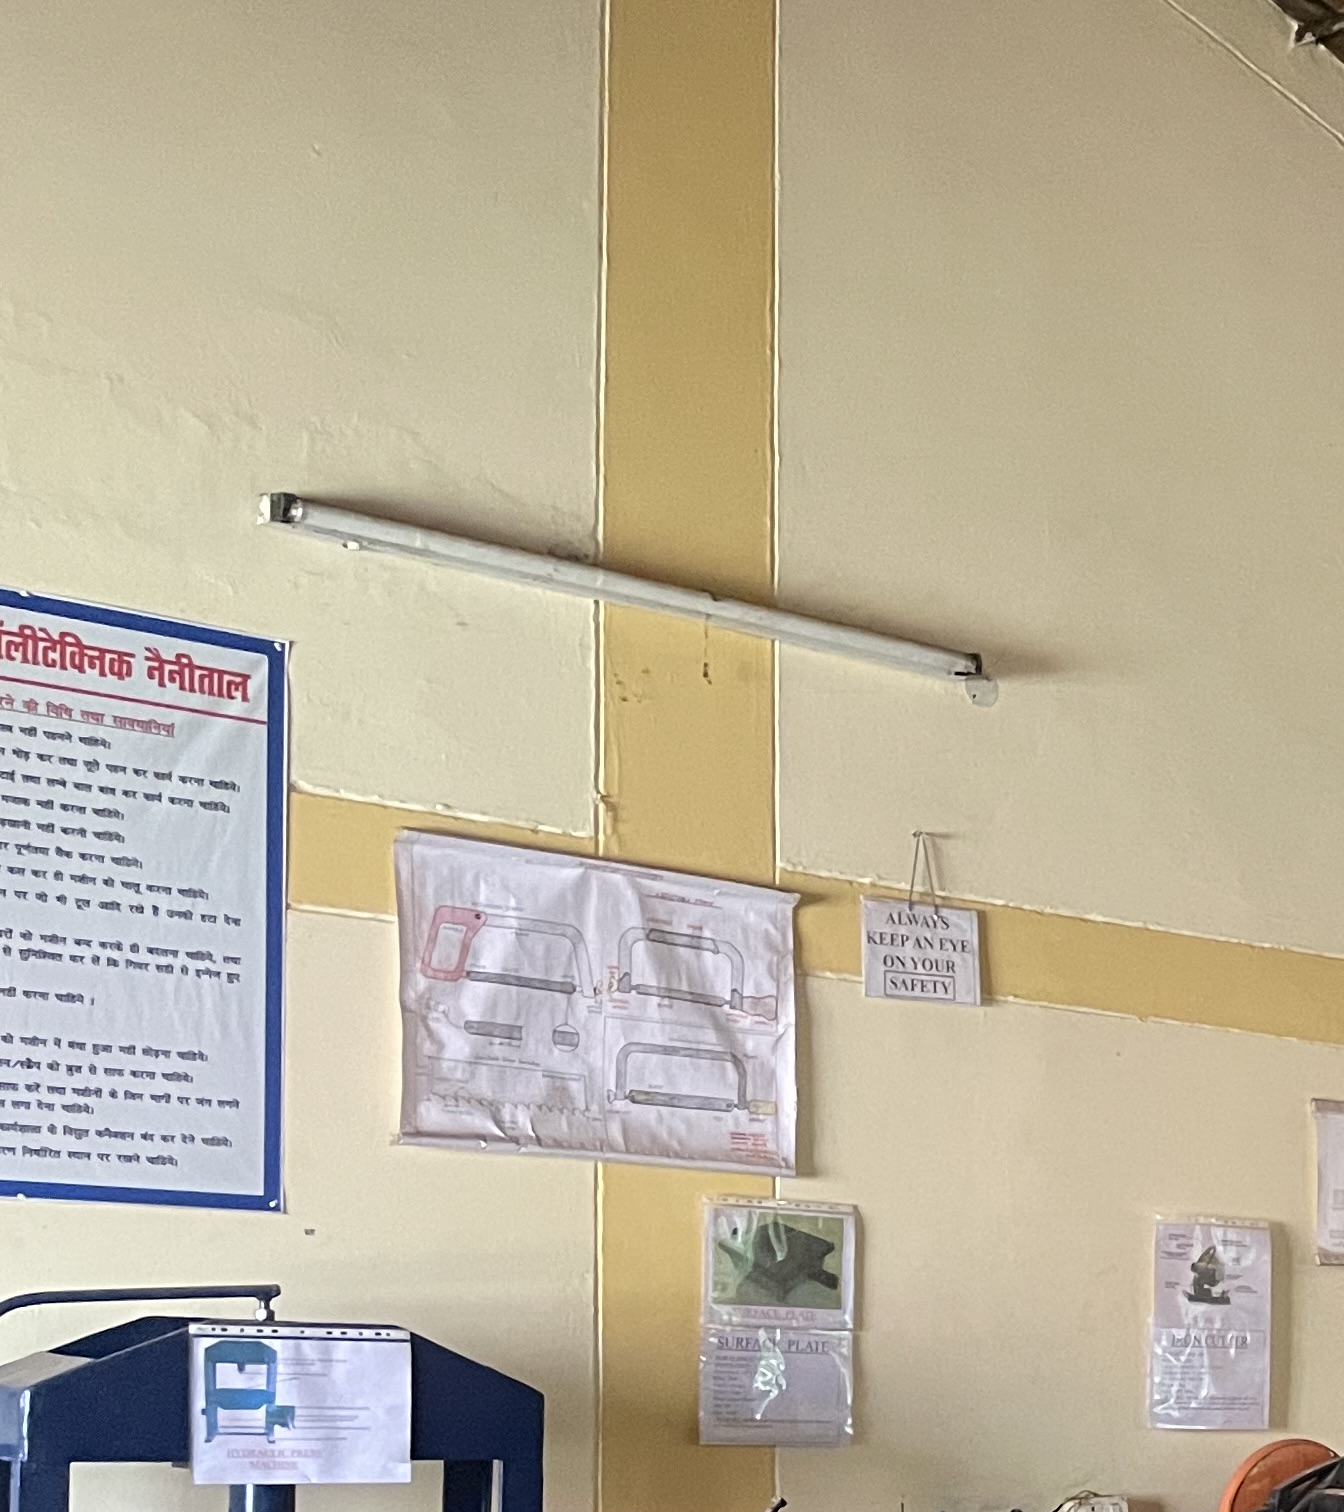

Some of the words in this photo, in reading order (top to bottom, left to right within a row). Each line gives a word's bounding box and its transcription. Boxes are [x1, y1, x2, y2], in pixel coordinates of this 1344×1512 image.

[0, 619, 136, 681] लीटेक्निक
[144, 646, 252, 703] नैनीताल
[80, 710, 105, 724] तथा
[886, 911, 950, 930] ALWAYS
[866, 930, 909, 947] KEEP
[913, 936, 934, 950] AN
[940, 937, 971, 953] EYE
[883, 954, 906, 968] ON
[910, 956, 956, 974] YOUR
[889, 976, 952, 994] SAFETY
[787, 1340, 831, 1353] PLATE
